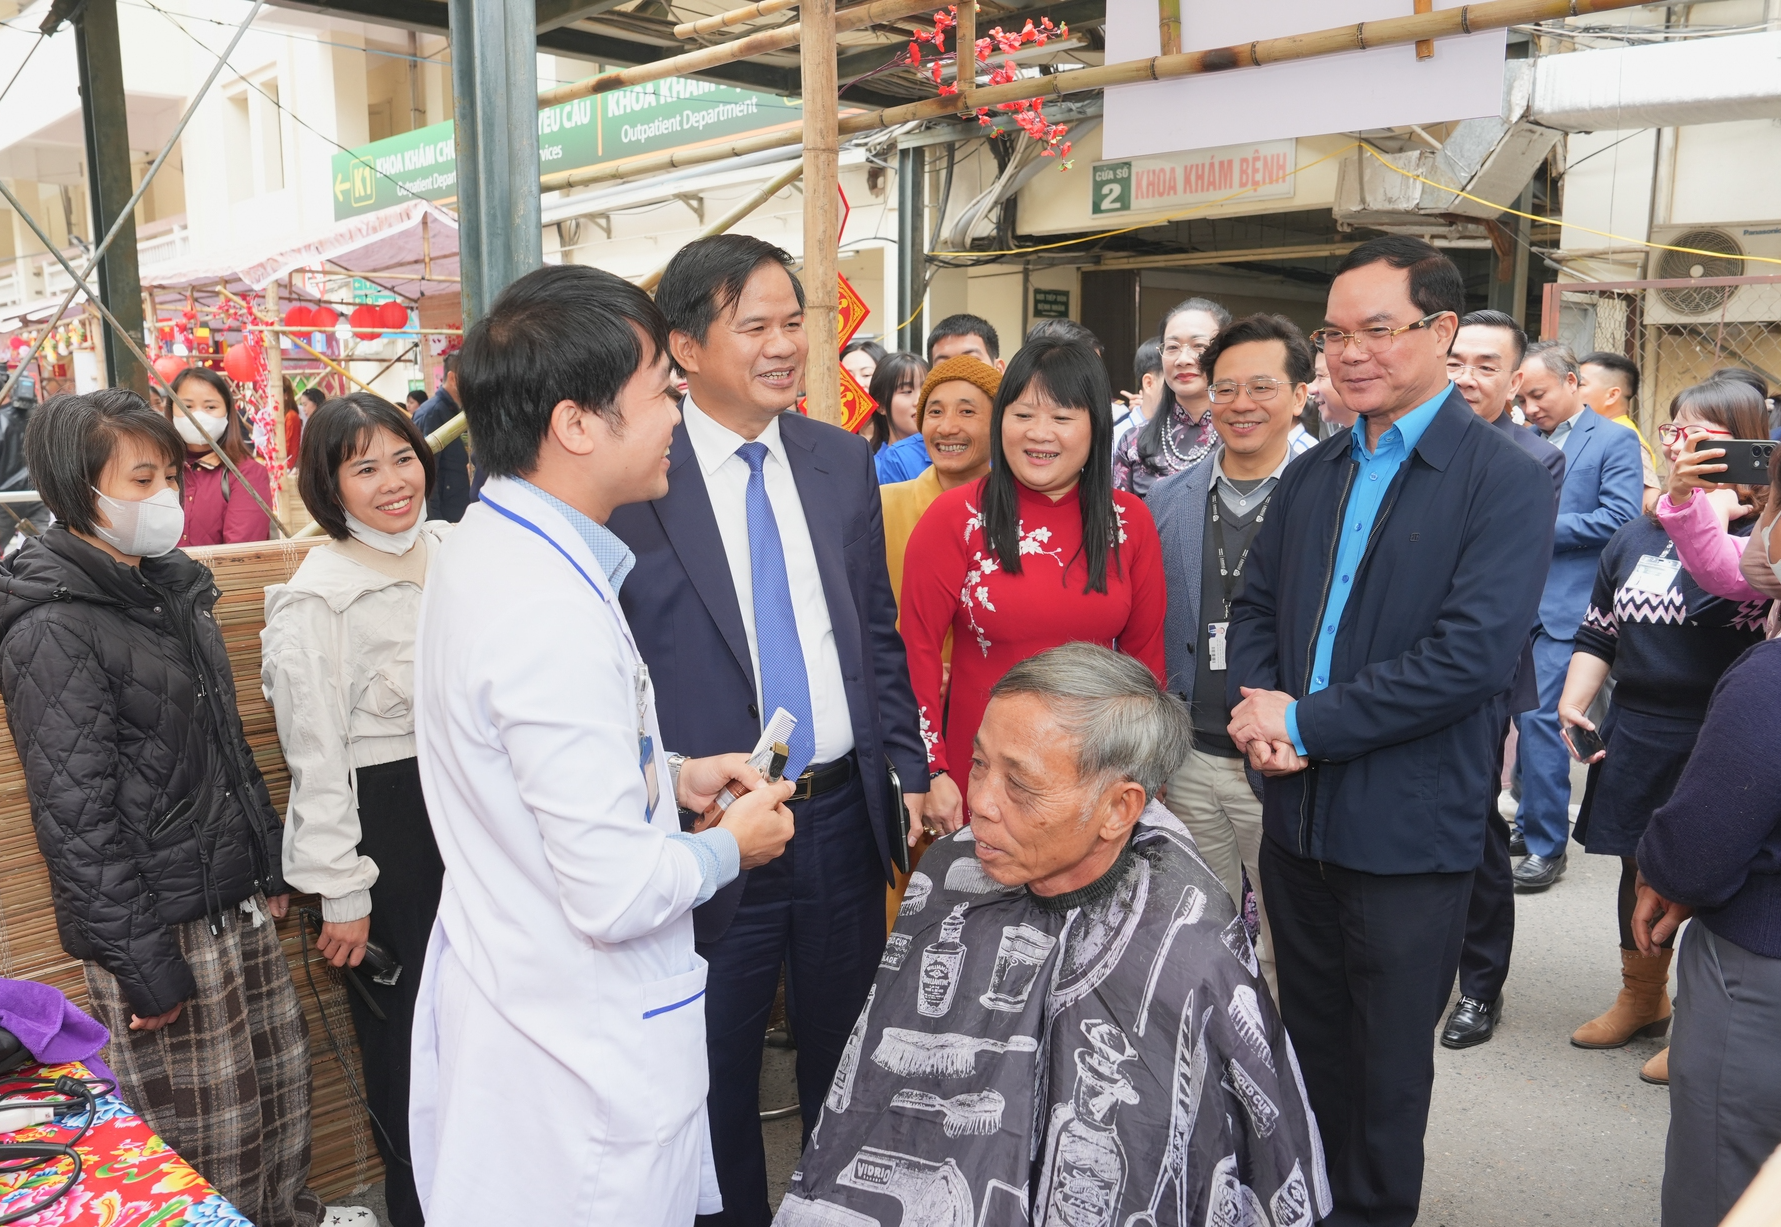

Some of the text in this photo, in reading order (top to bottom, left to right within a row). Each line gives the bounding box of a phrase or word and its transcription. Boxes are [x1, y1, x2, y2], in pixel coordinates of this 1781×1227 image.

[608, 85, 656, 117] KHOA
[621, 95, 757, 143] Outpatient Department
[376, 153, 403, 178] KHOA
[404, 143, 435, 171] KHÁM
[1135, 149, 1287, 200] KHOA KHÁM BỆNH
[354, 166, 371, 197] K1
[397, 176, 432, 197] Outpatient
[1100, 183, 1122, 210] 2
[857, 1161, 891, 1182] VIDRIO
